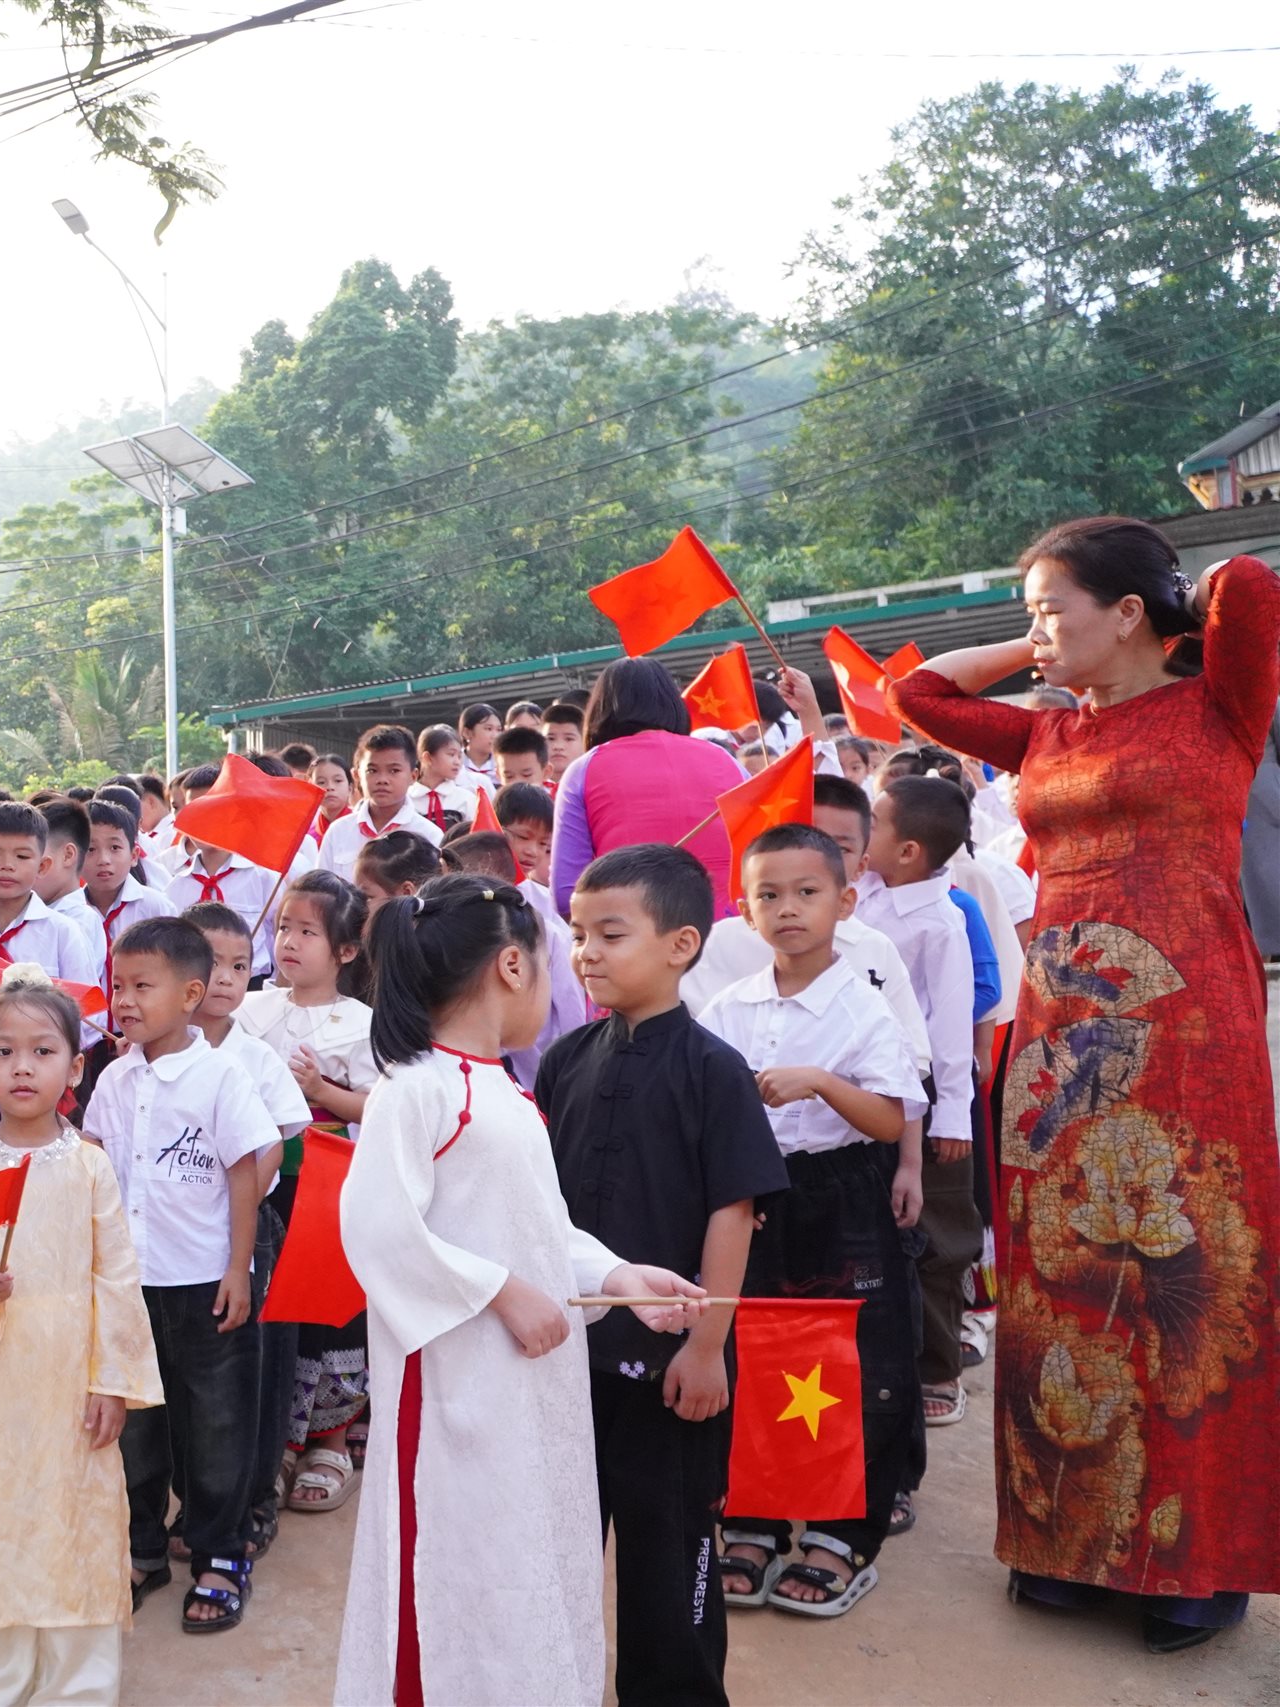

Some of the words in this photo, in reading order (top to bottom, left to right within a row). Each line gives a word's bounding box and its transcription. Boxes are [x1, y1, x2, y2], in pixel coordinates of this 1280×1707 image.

[155, 1126, 217, 1178] Action
[181, 1174, 213, 1184] ACTION
[693, 1537, 710, 1625] PREPARESTN
